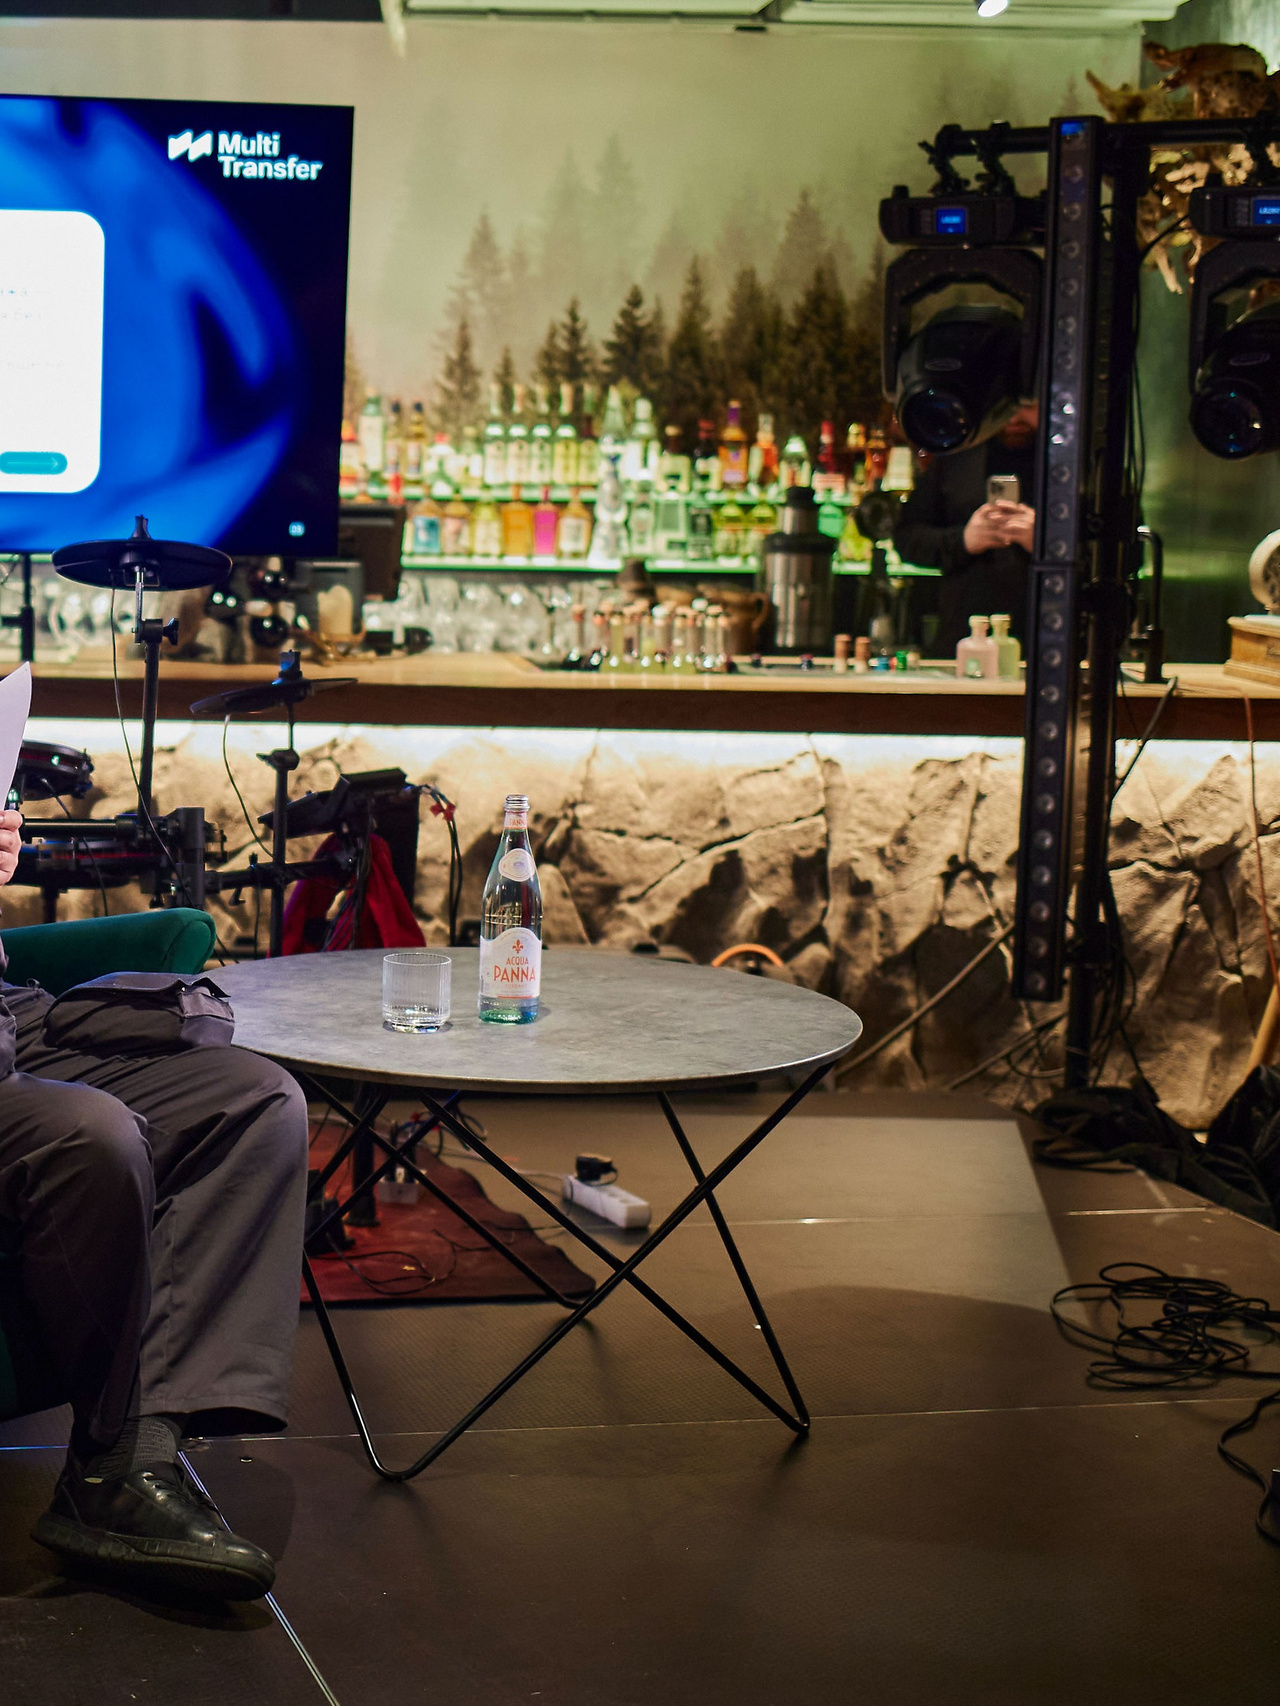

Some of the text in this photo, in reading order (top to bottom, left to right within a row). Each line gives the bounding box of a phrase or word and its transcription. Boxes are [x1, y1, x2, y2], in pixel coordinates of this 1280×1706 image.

[218, 130, 280, 157] Multi
[218, 154, 323, 180] Transfer
[506, 956, 529, 966] ACQUA
[493, 965, 536, 983] PANNA
